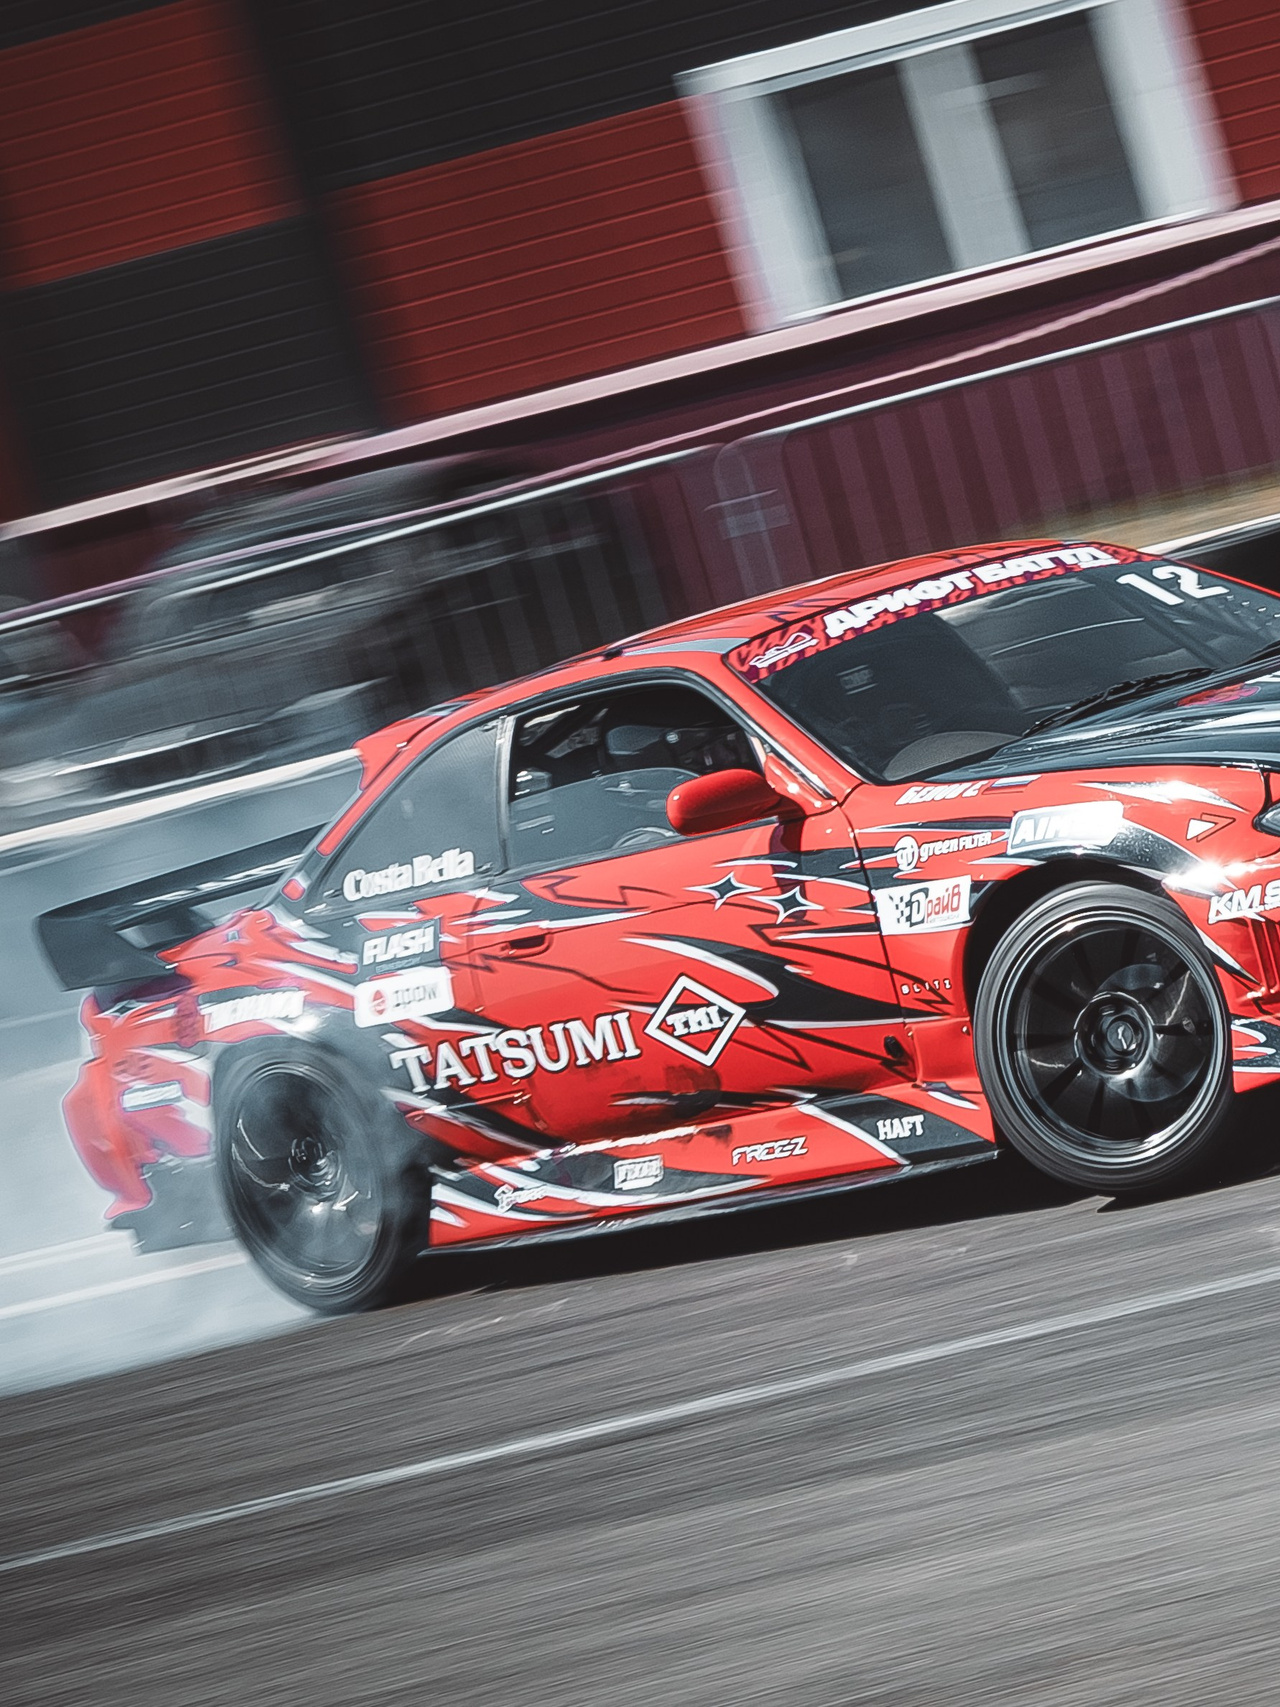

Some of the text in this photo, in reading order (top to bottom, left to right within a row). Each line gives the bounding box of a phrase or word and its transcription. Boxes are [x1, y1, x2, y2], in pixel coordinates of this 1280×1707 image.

[1116, 565, 1230, 606] 12
[342, 848, 476, 901] Costa Bella
[1208, 884, 1263, 925] KM
[362, 926, 435, 966] FLASH
[901, 979, 951, 995] BLITZ
[389, 1011, 641, 1093] TATSUMI
[876, 1114, 924, 1141] HAFT
